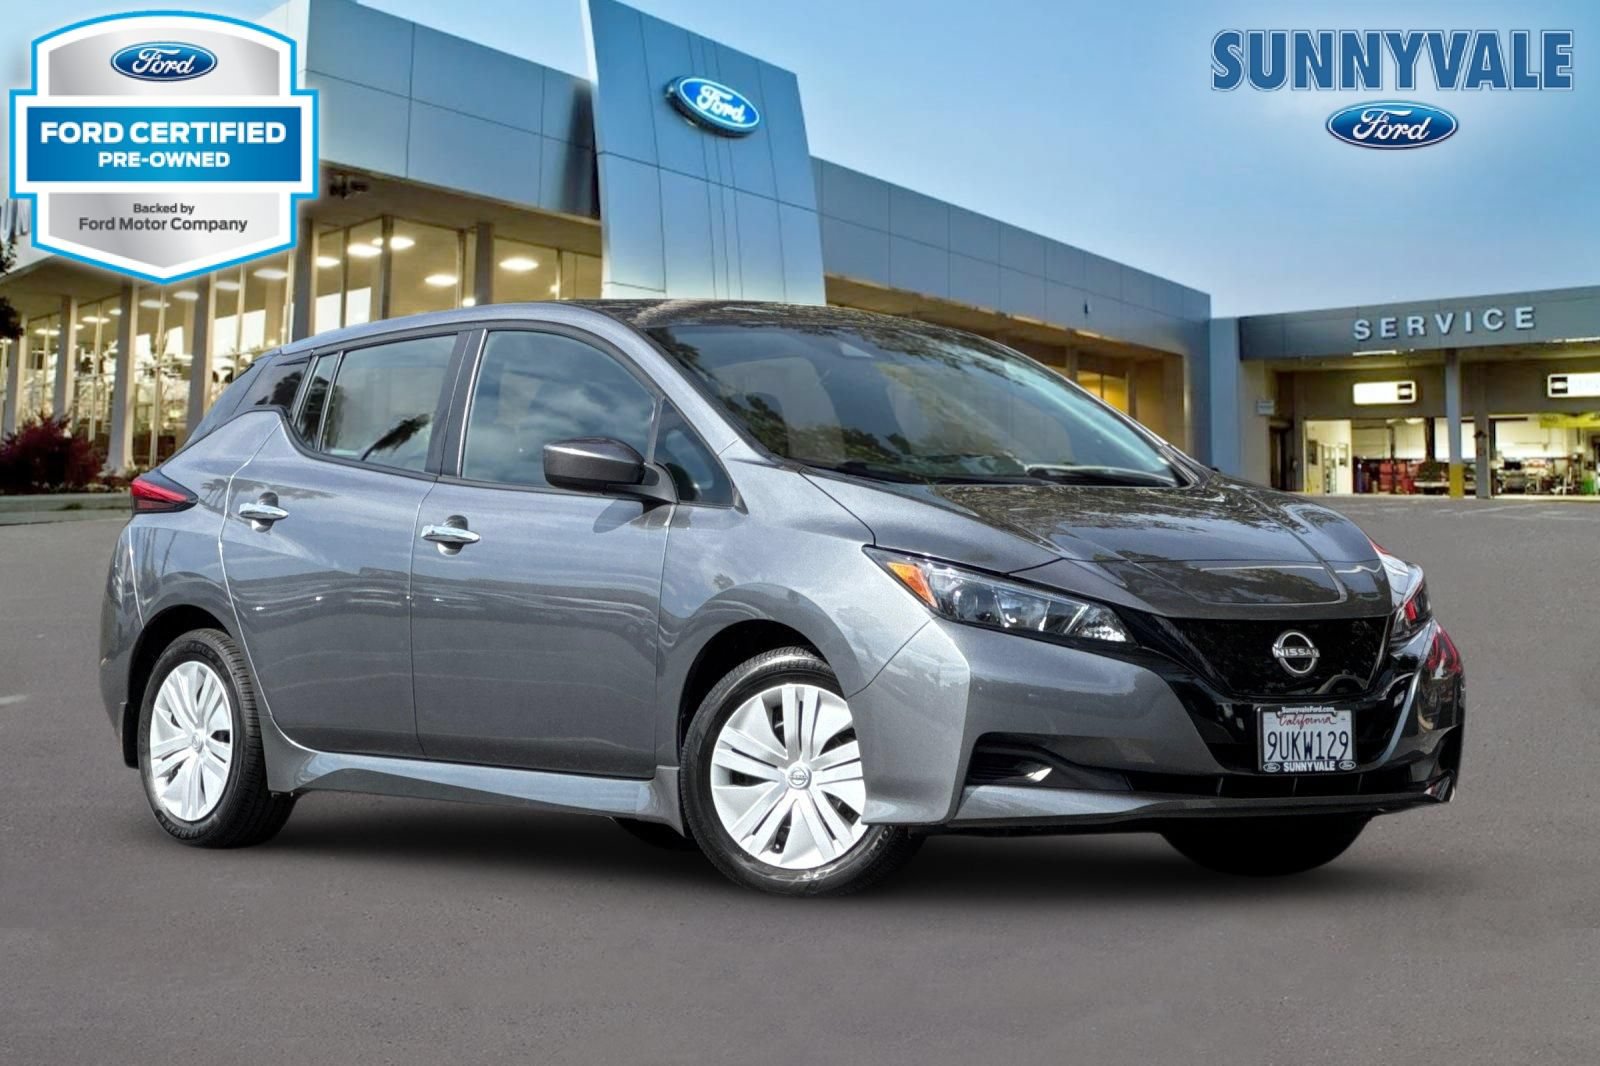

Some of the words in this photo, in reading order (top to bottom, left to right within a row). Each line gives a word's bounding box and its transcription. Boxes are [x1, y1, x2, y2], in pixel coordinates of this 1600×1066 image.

[696, 85, 746, 123] Ford
[1353, 306, 1536, 341] SERVICE
[1274, 647, 1320, 658] NISSAN
[1279, 714, 1337, 730] California
[1267, 731, 1349, 761] 9UKW129
[1283, 761, 1336, 772] SUNNYVALE
